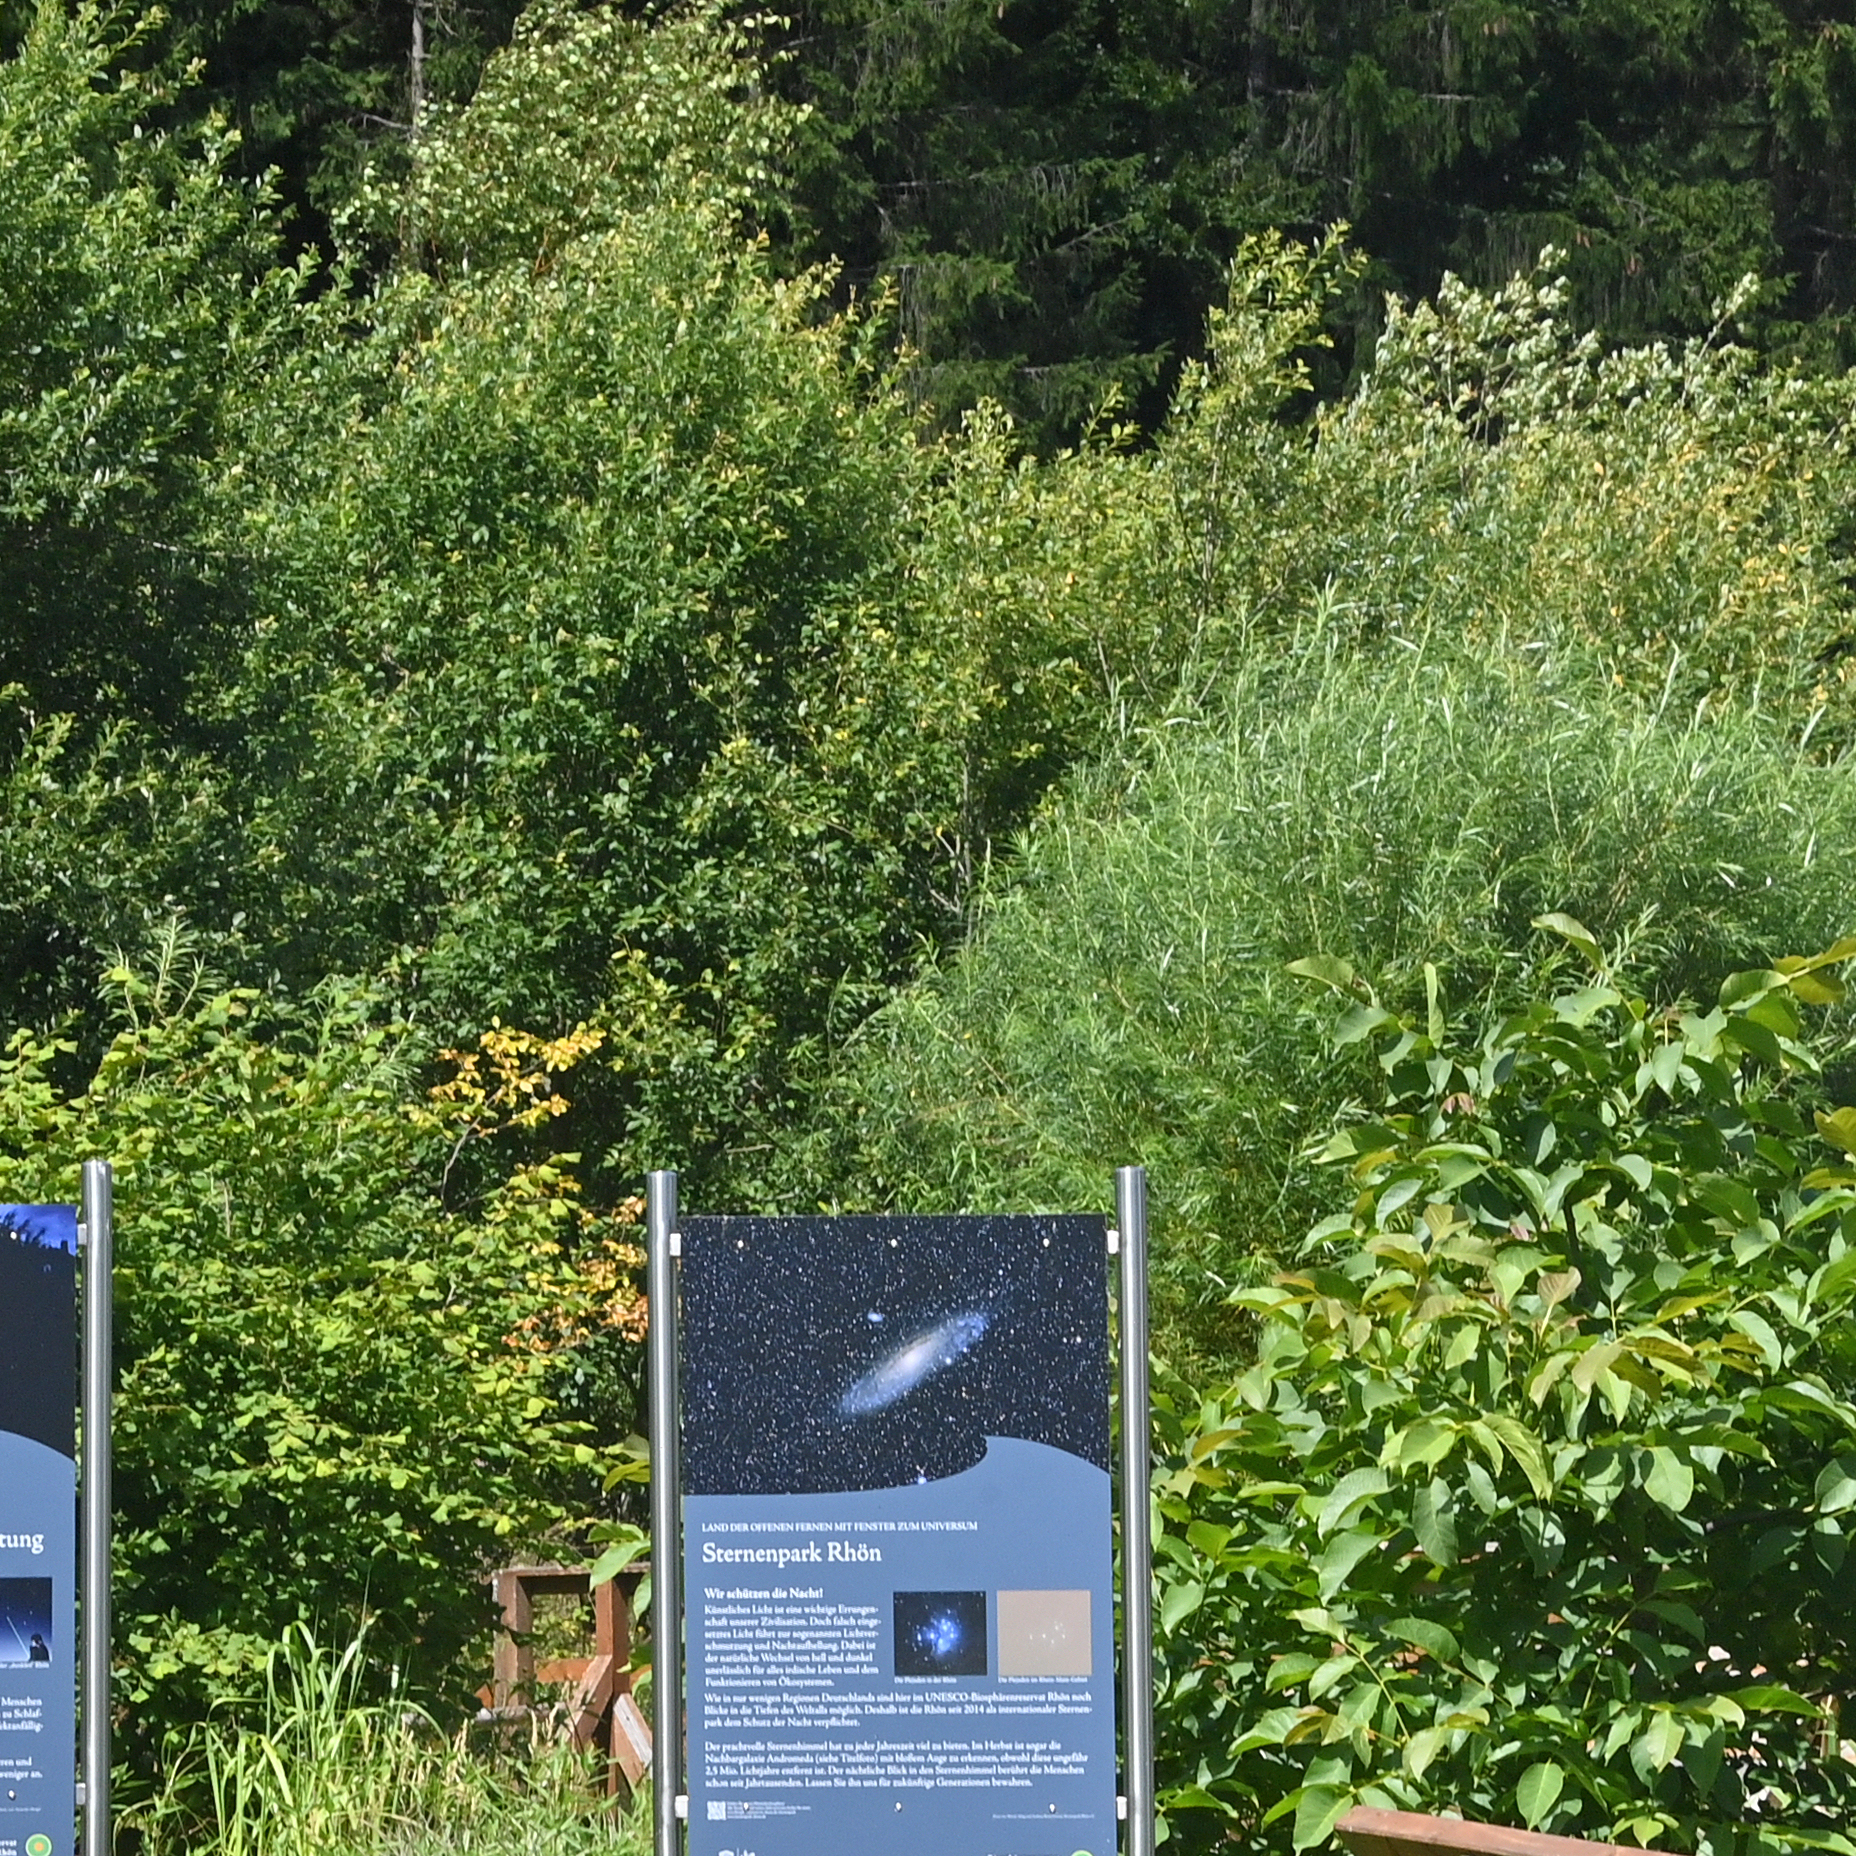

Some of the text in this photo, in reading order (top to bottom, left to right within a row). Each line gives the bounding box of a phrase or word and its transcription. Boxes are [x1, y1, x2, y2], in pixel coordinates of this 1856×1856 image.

[701, 1521, 978, 1533] LAND DER OFFENEN FERNEN MIT FENSTER ZUM UNIVERSUM
[702, 1540, 882, 1569] Sternenpark Rhön
[704, 1587, 824, 1600] Wir schützen die Nacht!
[704, 1603, 879, 1617] Künstliches Licht ist eine wichtige Errungen-
